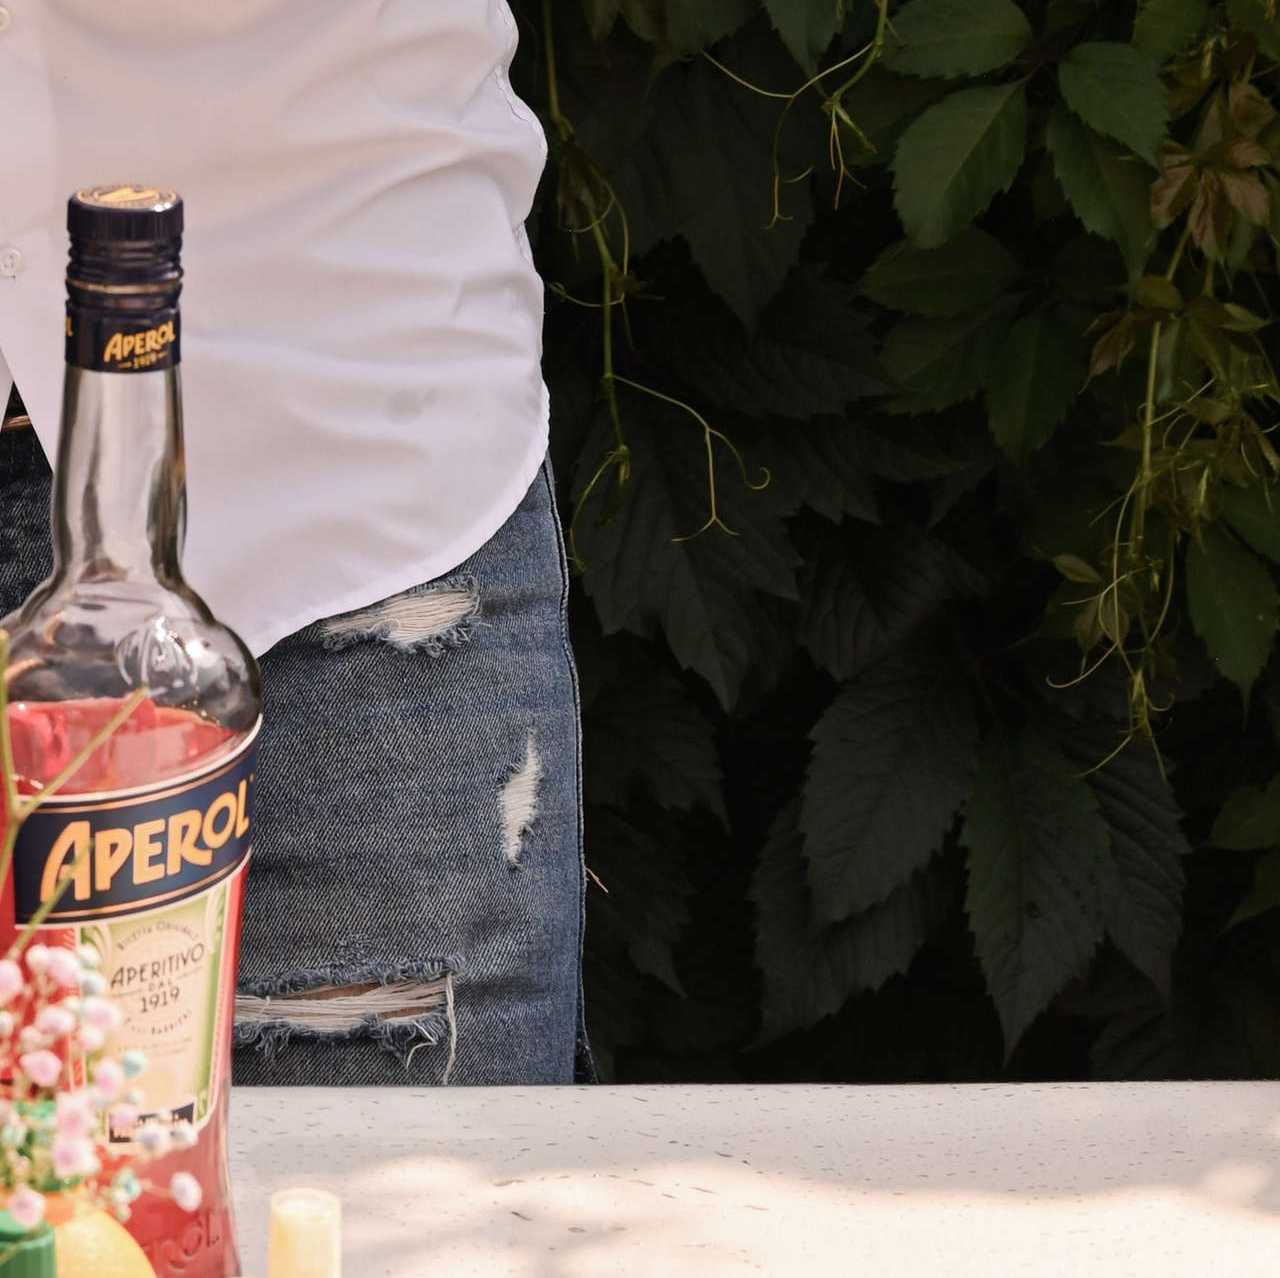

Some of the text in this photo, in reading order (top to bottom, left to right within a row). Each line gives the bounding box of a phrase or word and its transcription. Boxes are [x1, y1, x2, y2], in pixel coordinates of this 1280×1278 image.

[104, 320, 176, 362] APEROL
[133, 355, 157, 369] 1919
[40, 779, 250, 902] APEROL
[111, 943, 205, 989] APERITIVO
[140, 986, 180, 1014] 1919
[148, 980, 172, 992] DAL
